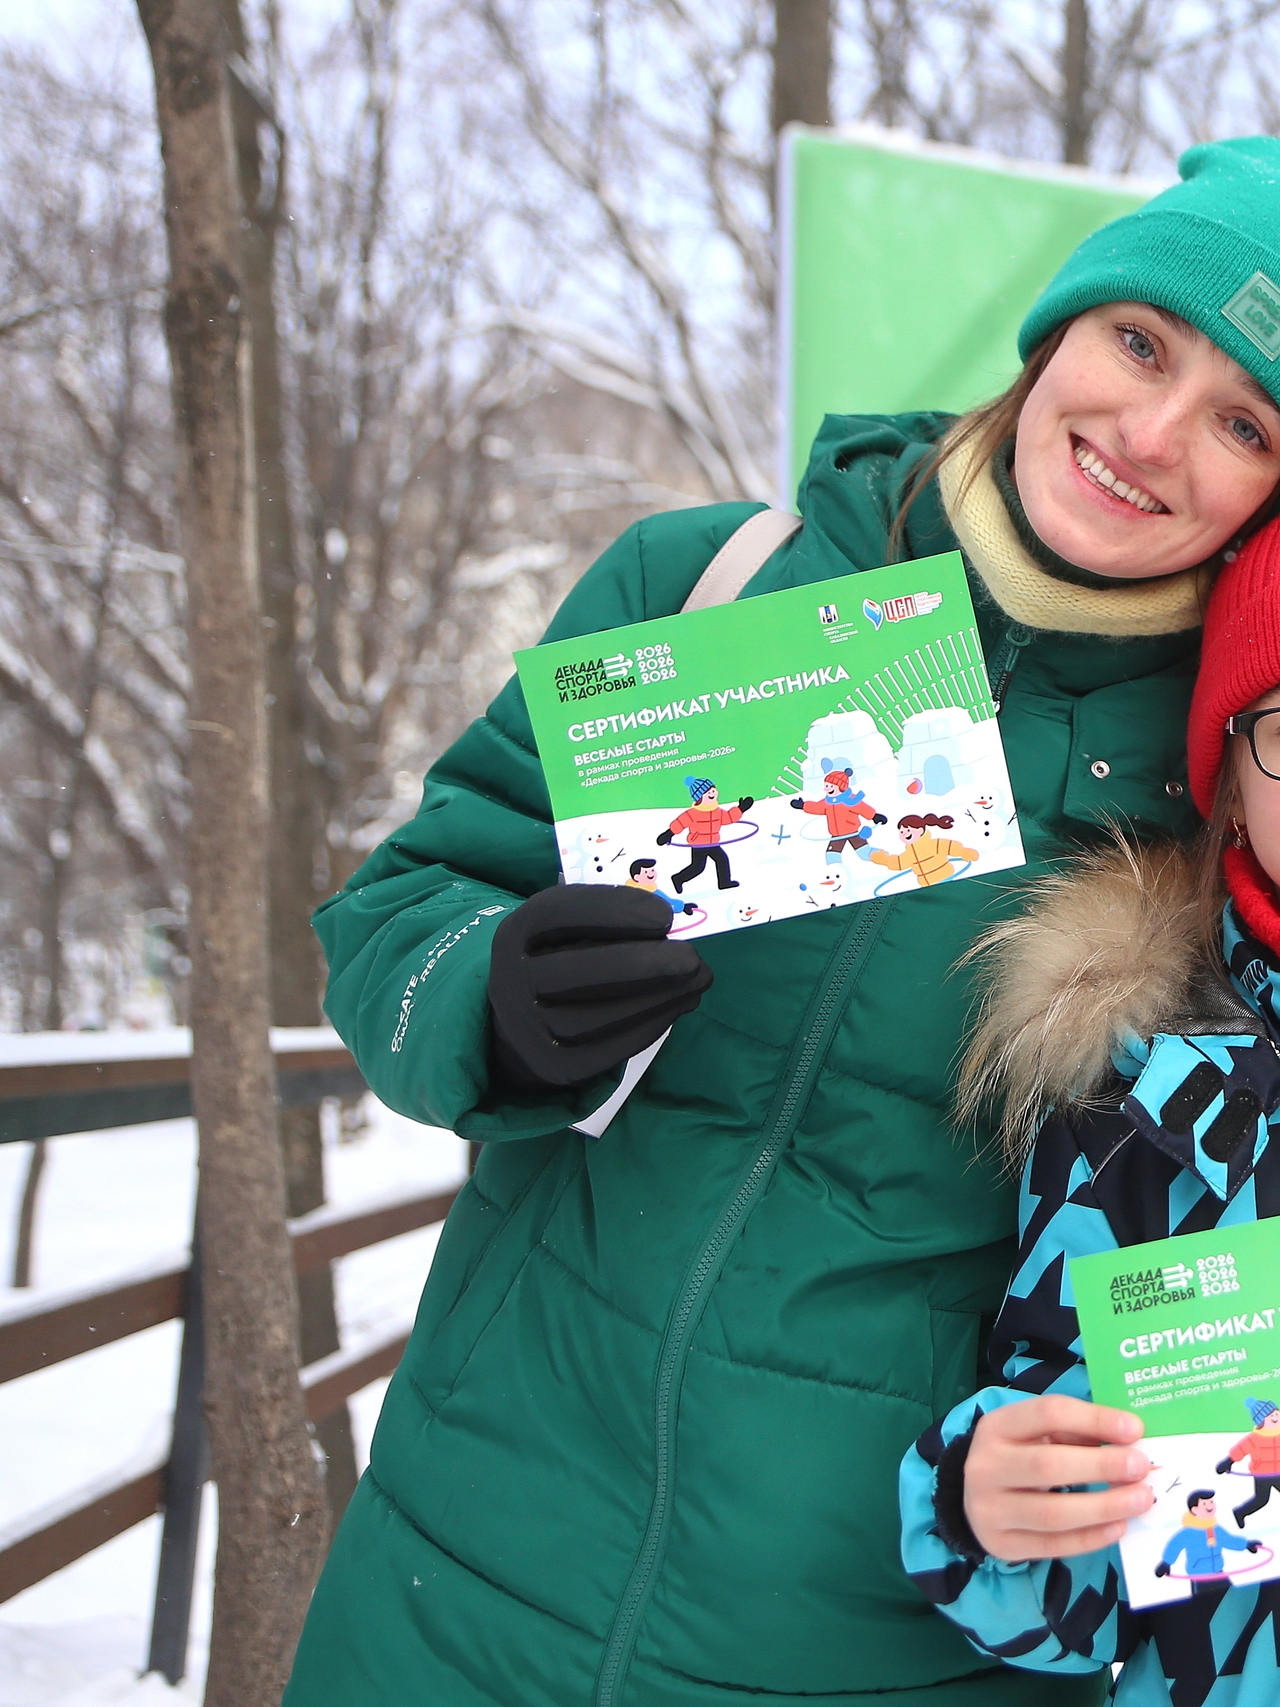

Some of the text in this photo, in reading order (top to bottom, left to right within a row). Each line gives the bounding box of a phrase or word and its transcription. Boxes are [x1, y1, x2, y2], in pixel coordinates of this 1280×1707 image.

[1244, 304, 1279, 337] LOVE
[884, 596, 916, 621] ЦСП
[635, 642, 672, 661] 2026
[638, 655, 675, 673] 2026
[554, 657, 605, 680] ДЕКАДА
[556, 670, 608, 691] СПОРТА
[641, 667, 678, 685] 2026
[559, 676, 637, 703] И ЗДОРОВЬЯ
[567, 664, 851, 743] СЕРТИФИКАТ УЧАСТНИКА
[574, 730, 686, 767] ВЕСЕЛЫЕ СТАРТЫ
[578, 748, 679, 777] в рамках проведения
[580, 772, 619, 788] «Декада
[620, 764, 654, 780] спорта
[663, 745, 736, 769] здоровья-2026»
[420, 916, 481, 982] REALITY
[1196, 1252, 1235, 1271] 2026
[1198, 1265, 1238, 1284] 2026
[1110, 1267, 1163, 1290] ДЕКАДА
[1111, 1280, 1166, 1301] СПОРТА
[1201, 1278, 1240, 1297] 2026
[1113, 1287, 1196, 1315] И ЗДОРОВЬЯ
[1119, 1308, 1277, 1358] СЕРТИФИКАТ
[1124, 1347, 1247, 1384] ВЕСЕЛЫЕ СТАРТЫ
[1128, 1365, 1239, 1397] в рамках проведения
[1130, 1391, 1172, 1408] «Декада
[1174, 1383, 1210, 1400] спорта
[1212, 1381, 1220, 1389] и
